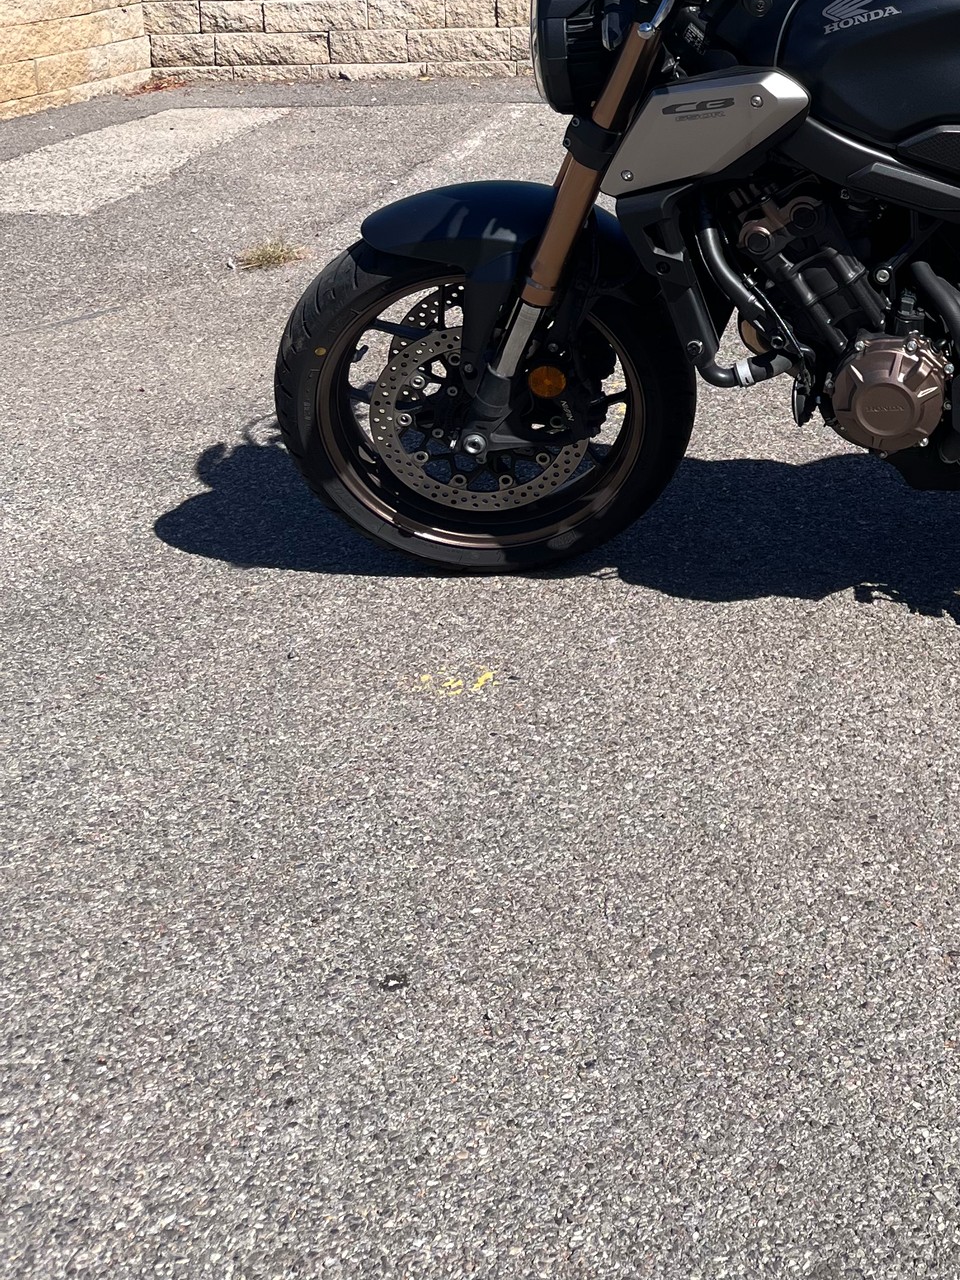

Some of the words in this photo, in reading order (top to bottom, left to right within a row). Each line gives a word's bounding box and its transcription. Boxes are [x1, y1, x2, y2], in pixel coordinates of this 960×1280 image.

[824, 6, 902, 35] HONDA
[662, 97, 735, 115] CB
[864, 405, 905, 413] HONDA
